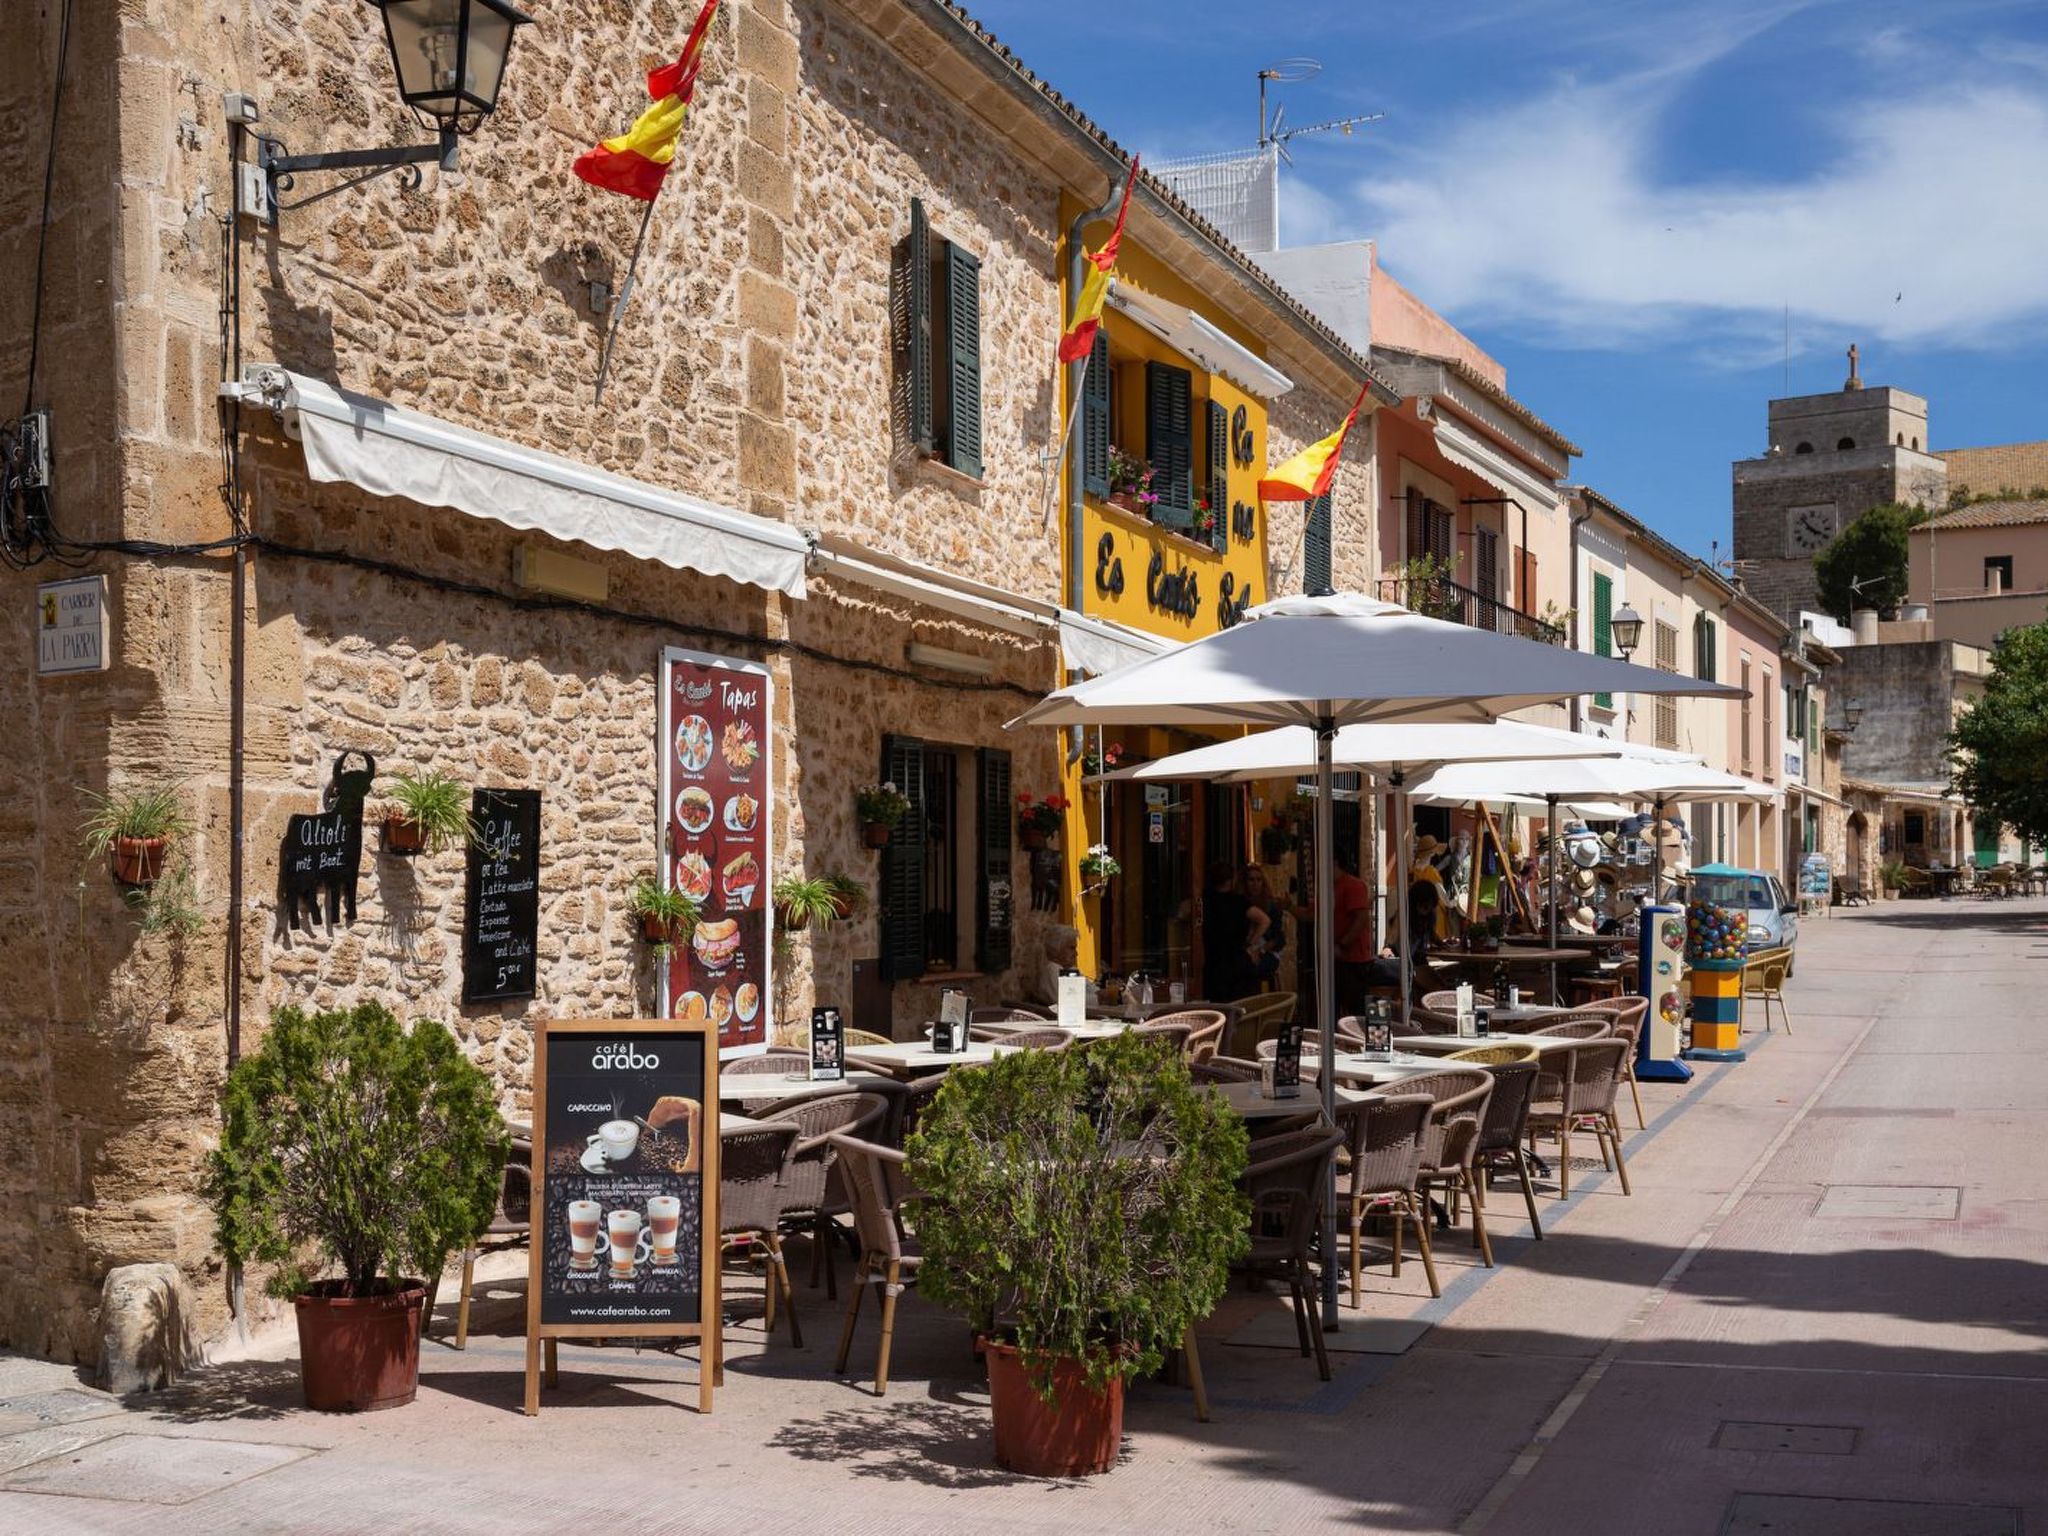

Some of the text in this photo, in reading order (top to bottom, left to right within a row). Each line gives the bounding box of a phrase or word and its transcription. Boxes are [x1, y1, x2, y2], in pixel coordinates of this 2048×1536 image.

[1096, 532, 1124, 595] Es
[61, 591, 96, 610] CARRER
[42, 631, 97, 662] LA PARRA
[720, 681, 757, 714] Tapas
[296, 855, 312, 872] mit
[592, 1042, 660, 1070] arabo
[596, 1043, 628, 1054] café
[566, 1103, 612, 1112] CAPUCCINO
[570, 1305, 671, 1316] www.cafearabo.com
